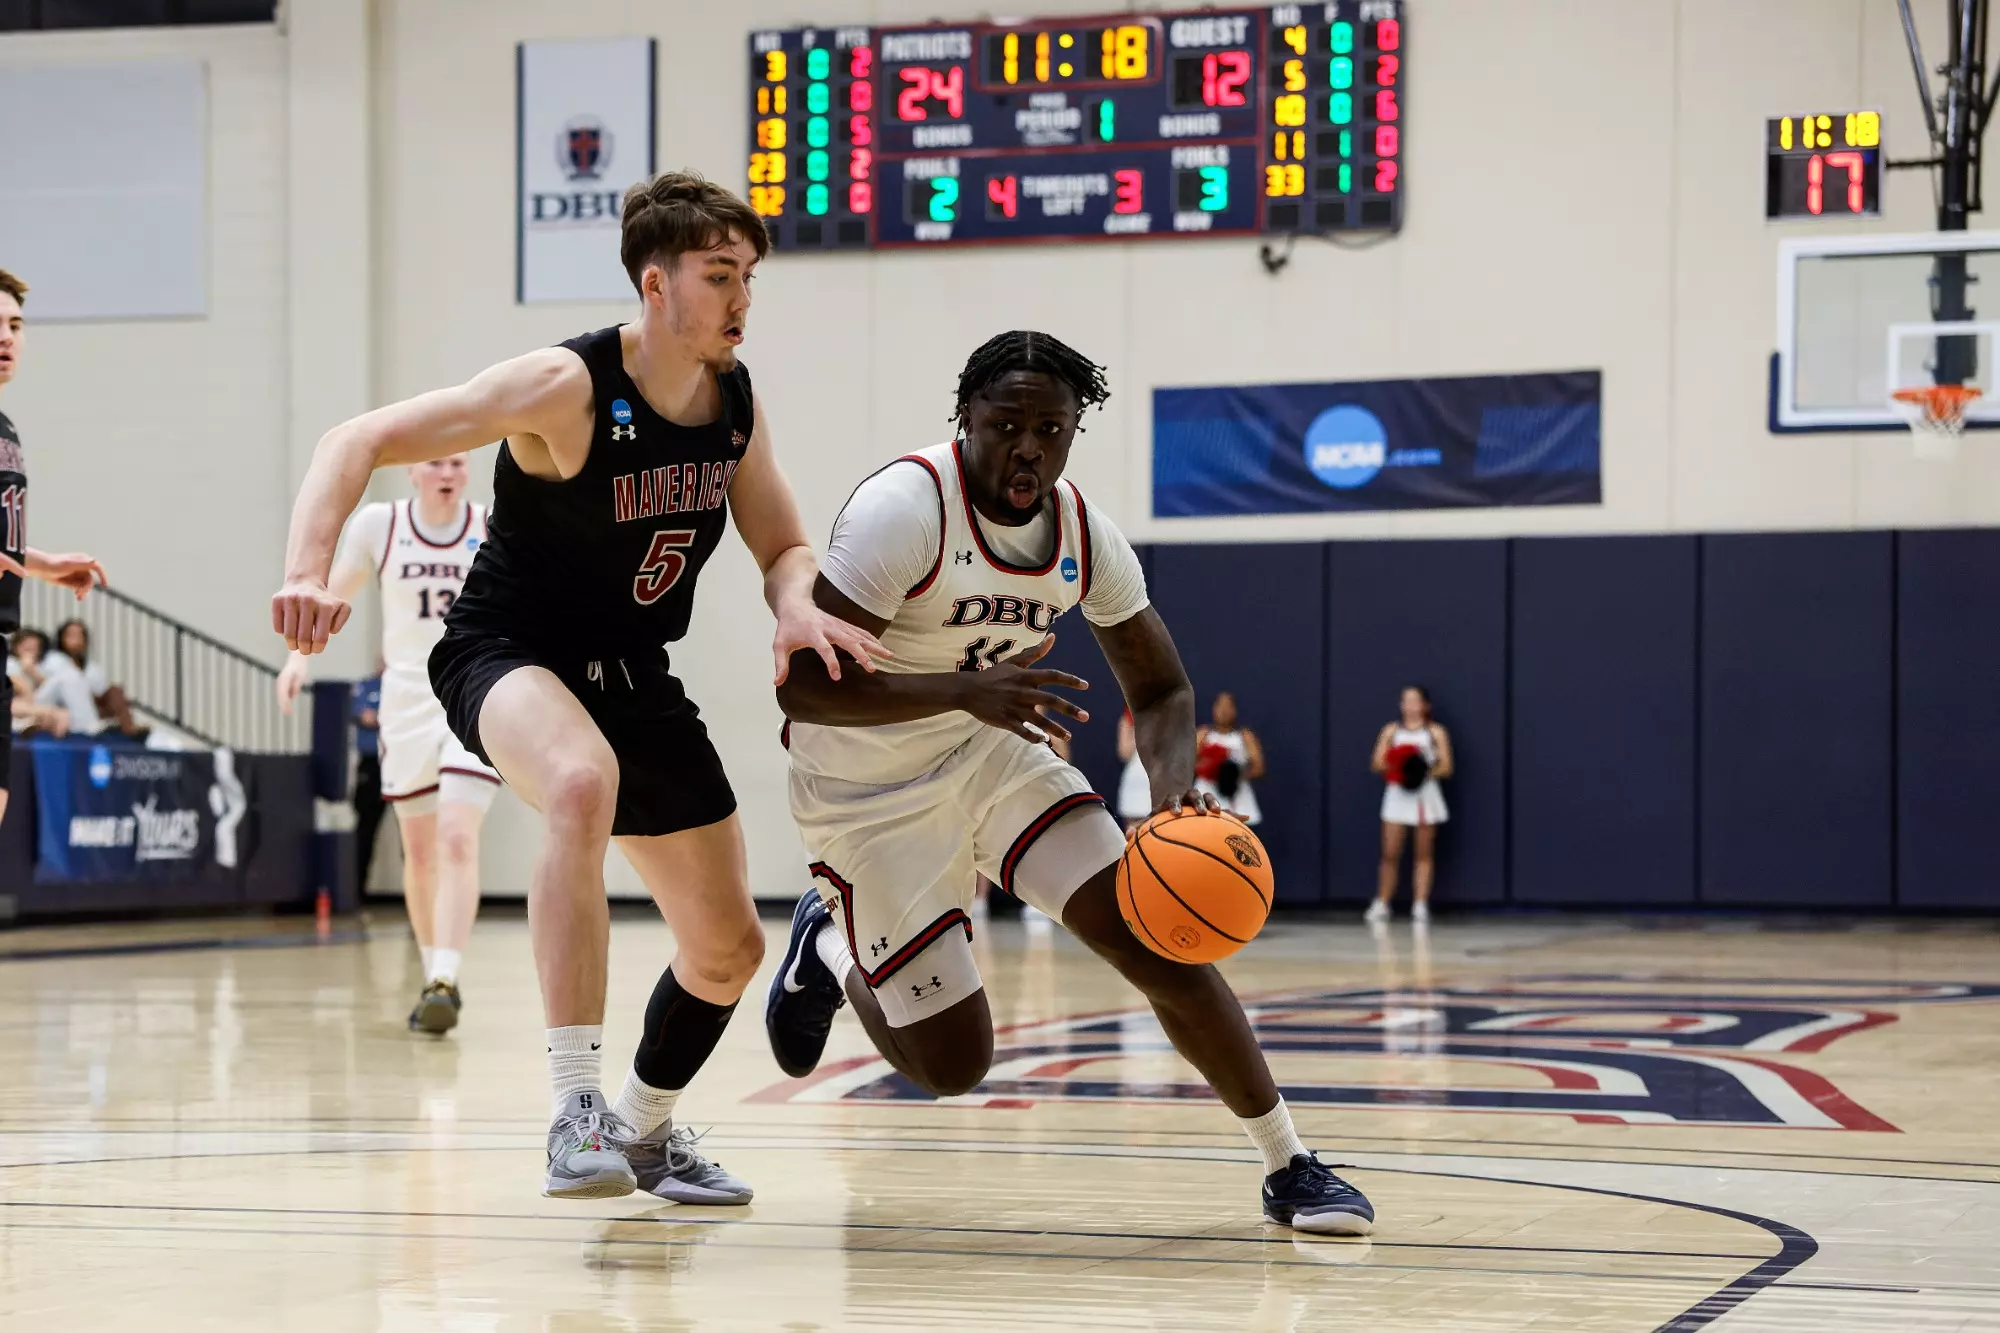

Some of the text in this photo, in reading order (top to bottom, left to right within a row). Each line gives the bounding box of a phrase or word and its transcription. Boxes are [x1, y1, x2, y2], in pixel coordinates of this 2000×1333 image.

[881, 32, 971, 61] PATRIOTS
[1170, 17, 1248, 47] GUEST
[1284, 25, 1307, 55] 4
[1377, 19, 1399, 51] 0
[765, 50, 786, 81] 3
[851, 46, 872, 78] 2
[1004, 25, 1148, 84] 11:18
[1284, 59, 1306, 91] 5
[1376, 54, 1399, 86] 2
[898, 66, 963, 121] 24
[1203, 51, 1251, 106] 12
[757, 86, 786, 115] 11
[850, 114, 872, 145] 5
[1100, 99, 1114, 142] 1
[1780, 111, 1880, 150] 11:18
[1275, 125, 1398, 160] 11 1 0
[748, 152, 786, 183] 23
[850, 148, 872, 179] 2
[1265, 160, 1397, 196] 33 1 2
[1807, 152, 1863, 215] 17
[929, 177, 959, 221] 2
[988, 175, 1017, 218] 4
[1113, 169, 1142, 214] 3
[1199, 165, 1228, 211] 3
[633, 529, 696, 605] 5
[942, 594, 1063, 633] DBU
